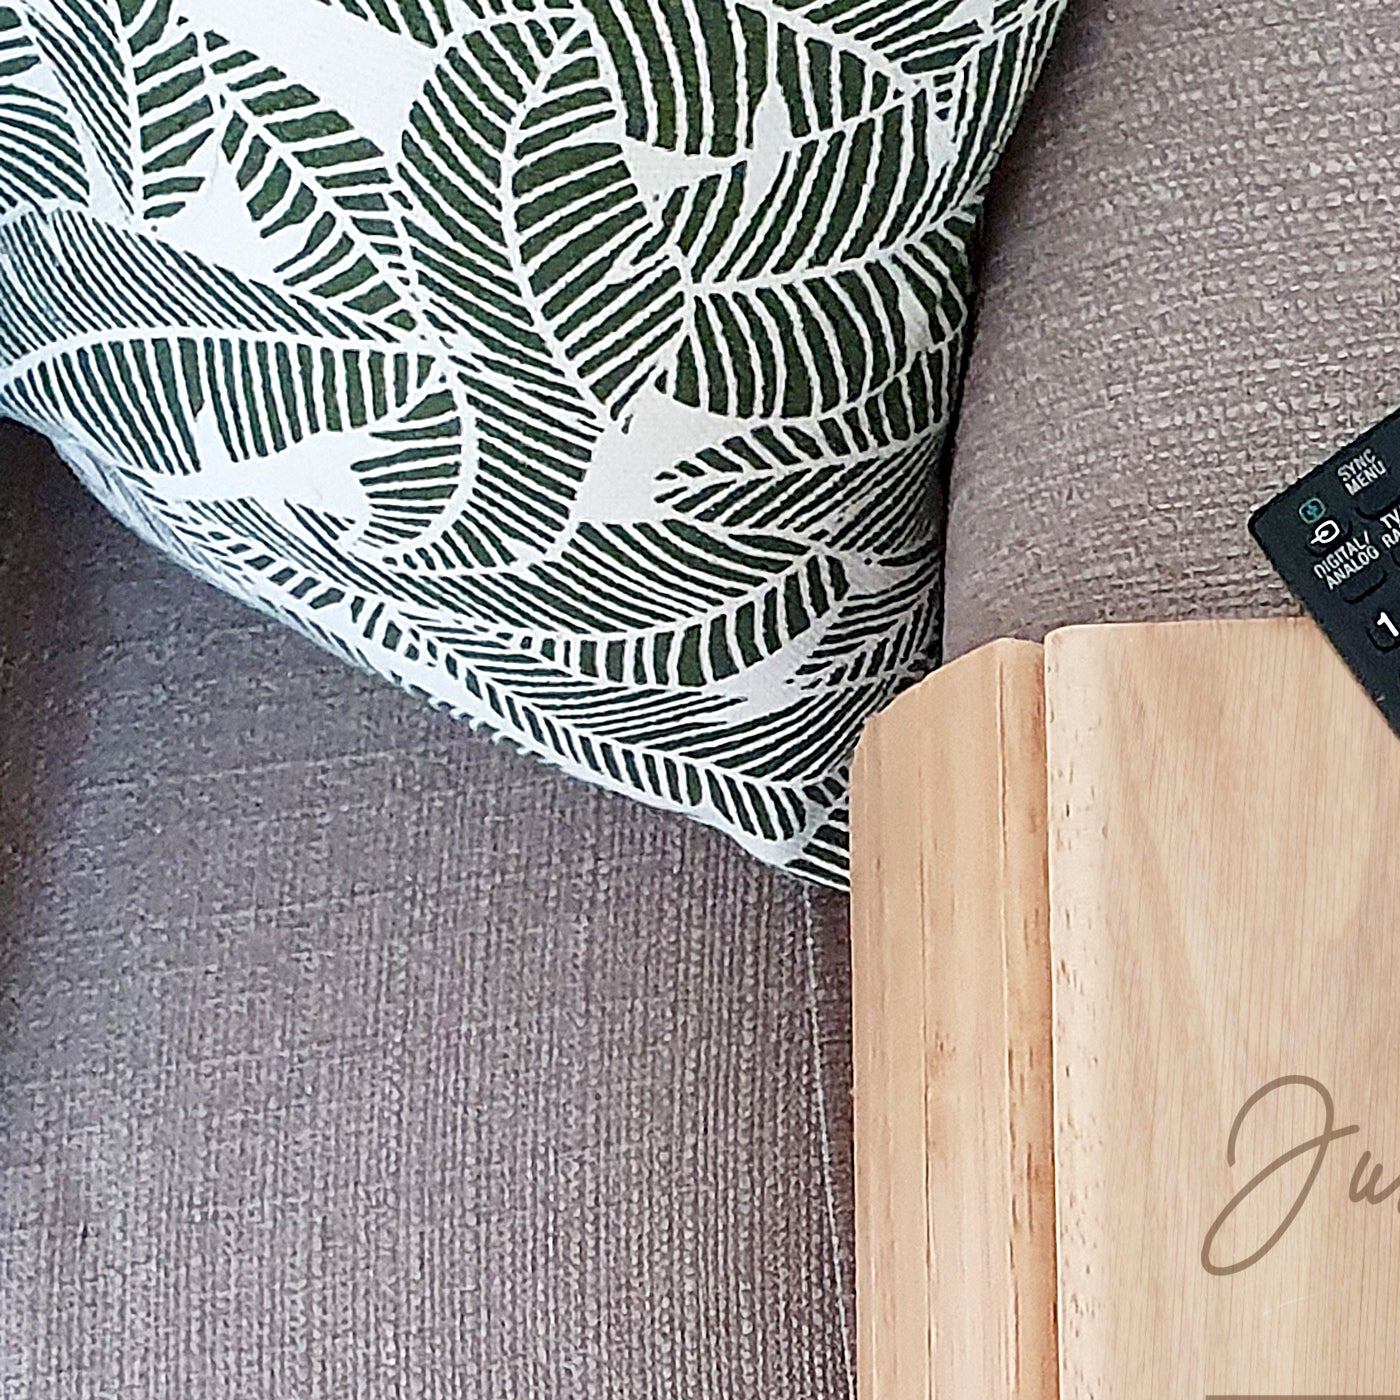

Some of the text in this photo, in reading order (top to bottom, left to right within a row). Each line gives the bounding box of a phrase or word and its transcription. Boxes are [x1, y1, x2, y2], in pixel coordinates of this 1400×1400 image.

[1337, 448, 1377, 482] SYNC
[1344, 460, 1387, 496] MENU
[1325, 545, 1380, 590] ANALOG
[1375, 610, 1400, 638] 1
